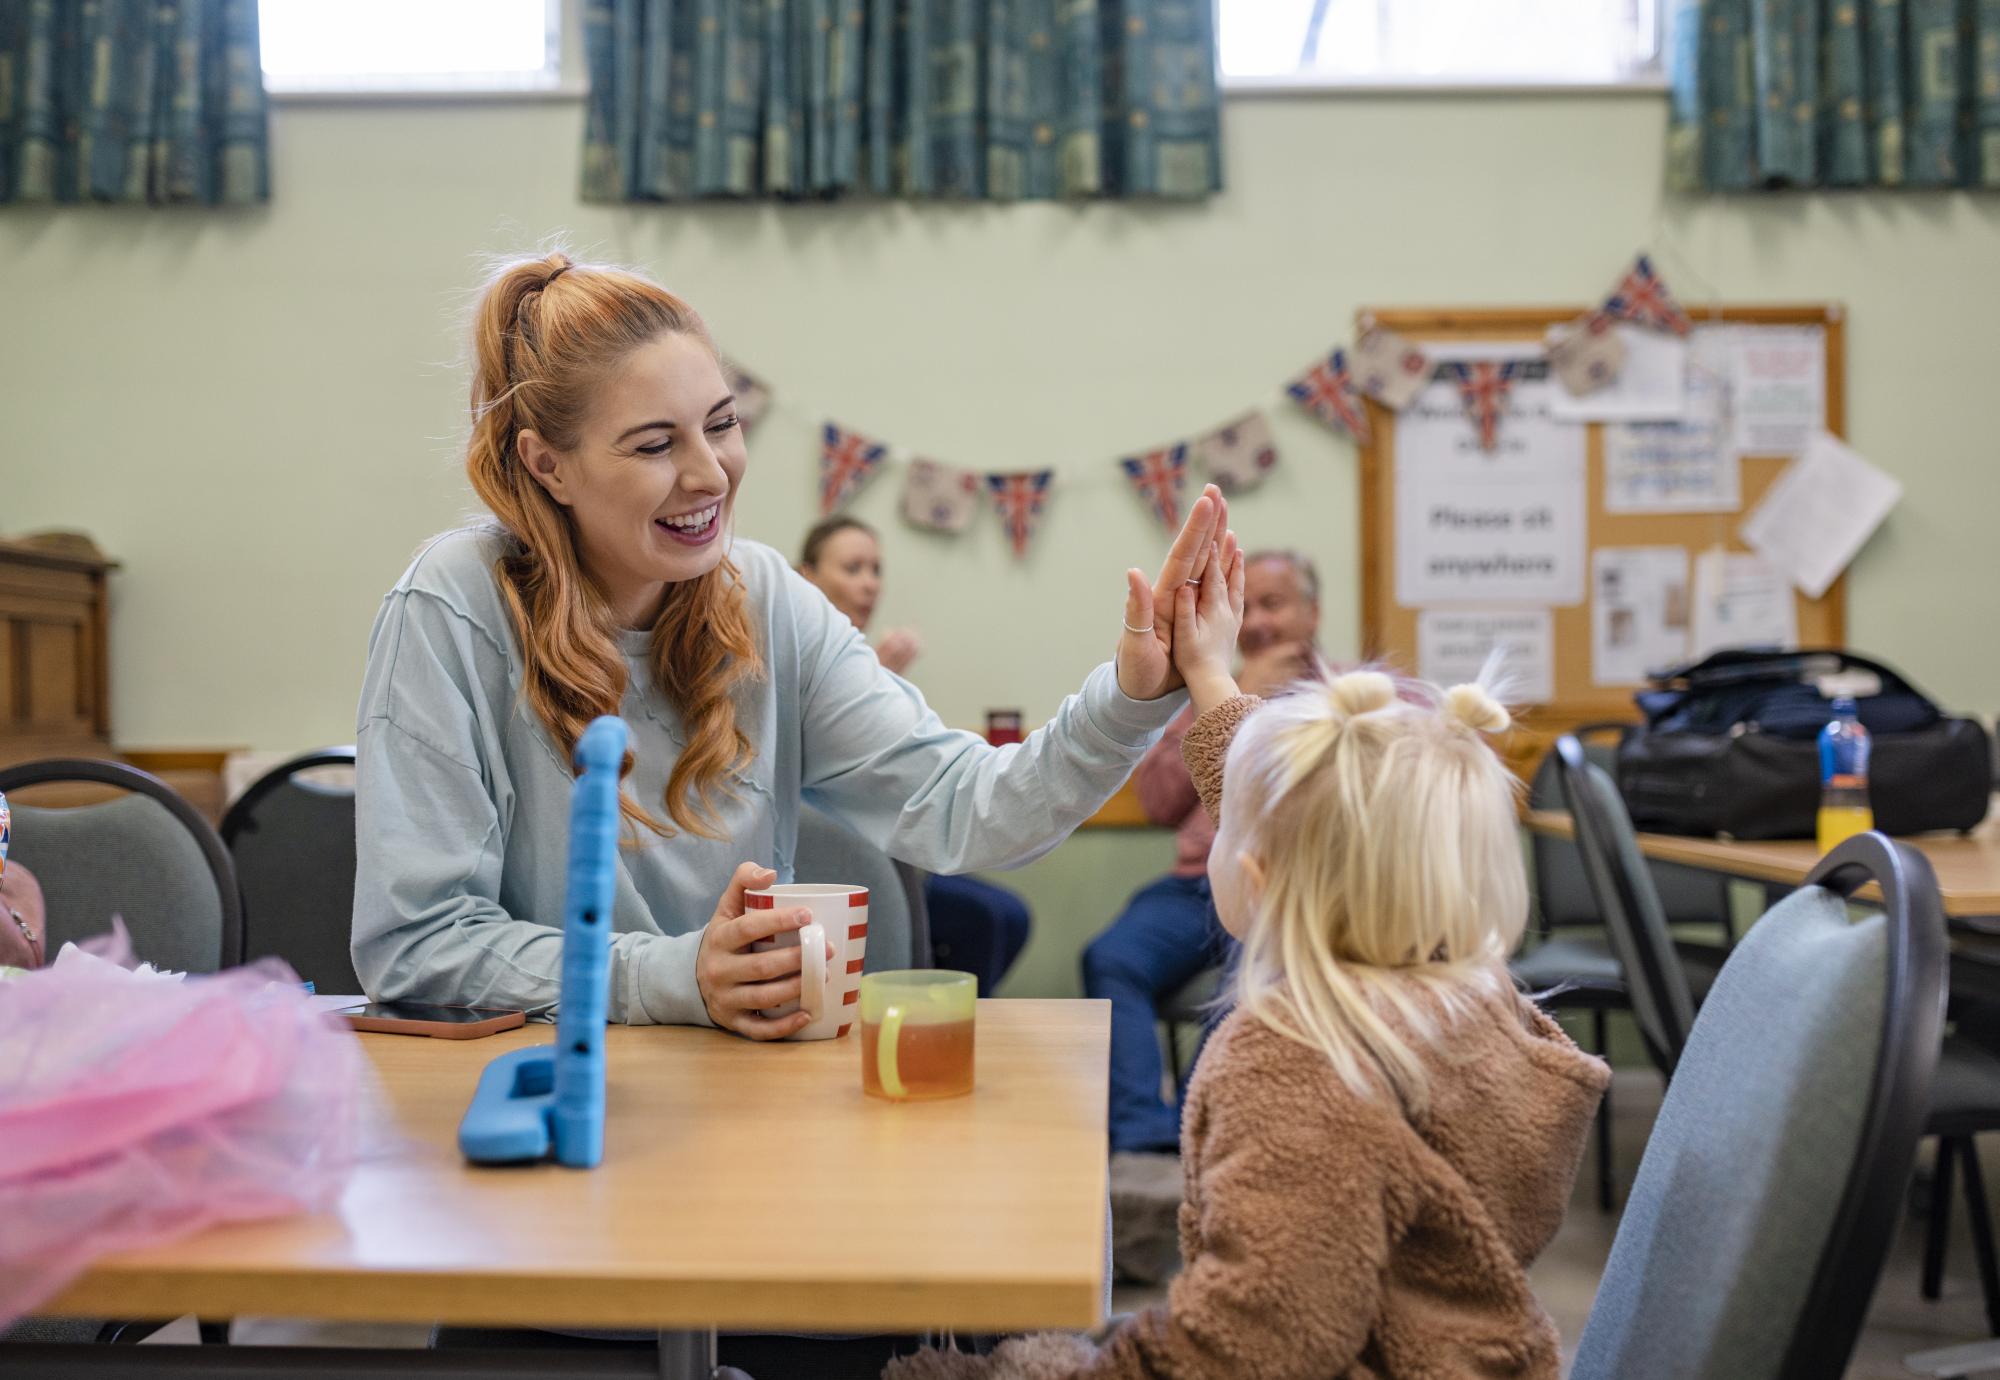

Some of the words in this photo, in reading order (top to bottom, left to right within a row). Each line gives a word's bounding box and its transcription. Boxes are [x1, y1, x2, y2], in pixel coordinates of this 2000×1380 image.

[1429, 506, 1511, 531] Please
[1519, 506, 1553, 531] sit
[1427, 549, 1555, 580] anywhere
